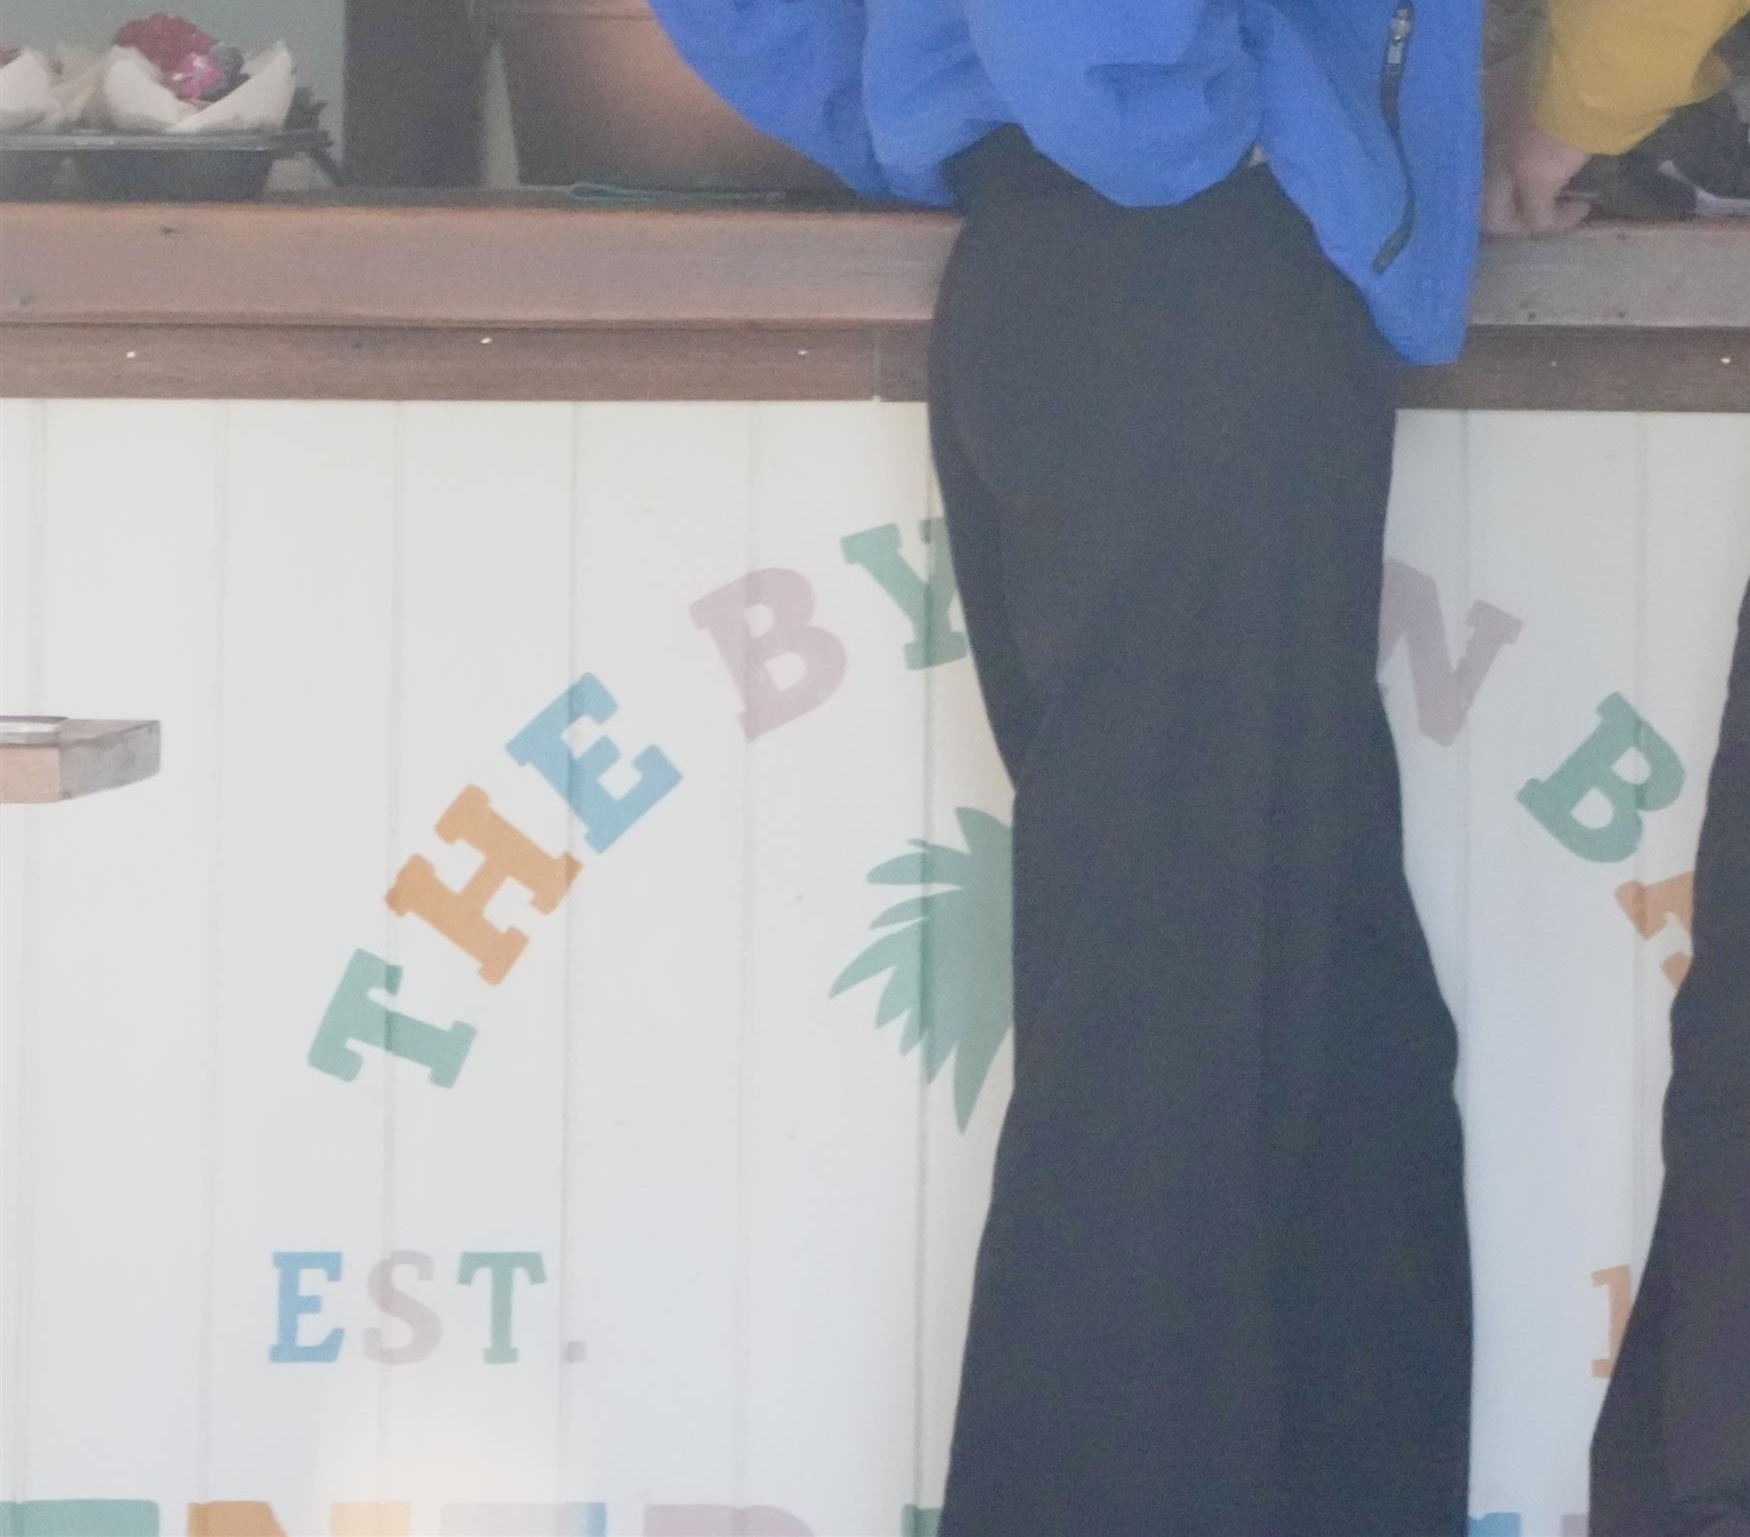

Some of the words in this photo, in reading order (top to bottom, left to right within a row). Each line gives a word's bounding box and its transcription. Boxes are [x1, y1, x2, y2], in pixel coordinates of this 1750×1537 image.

[307, 671, 684, 1090] THE
[688, 516, 1524, 748] BYN
[268, 1250, 587, 1365] EST.
